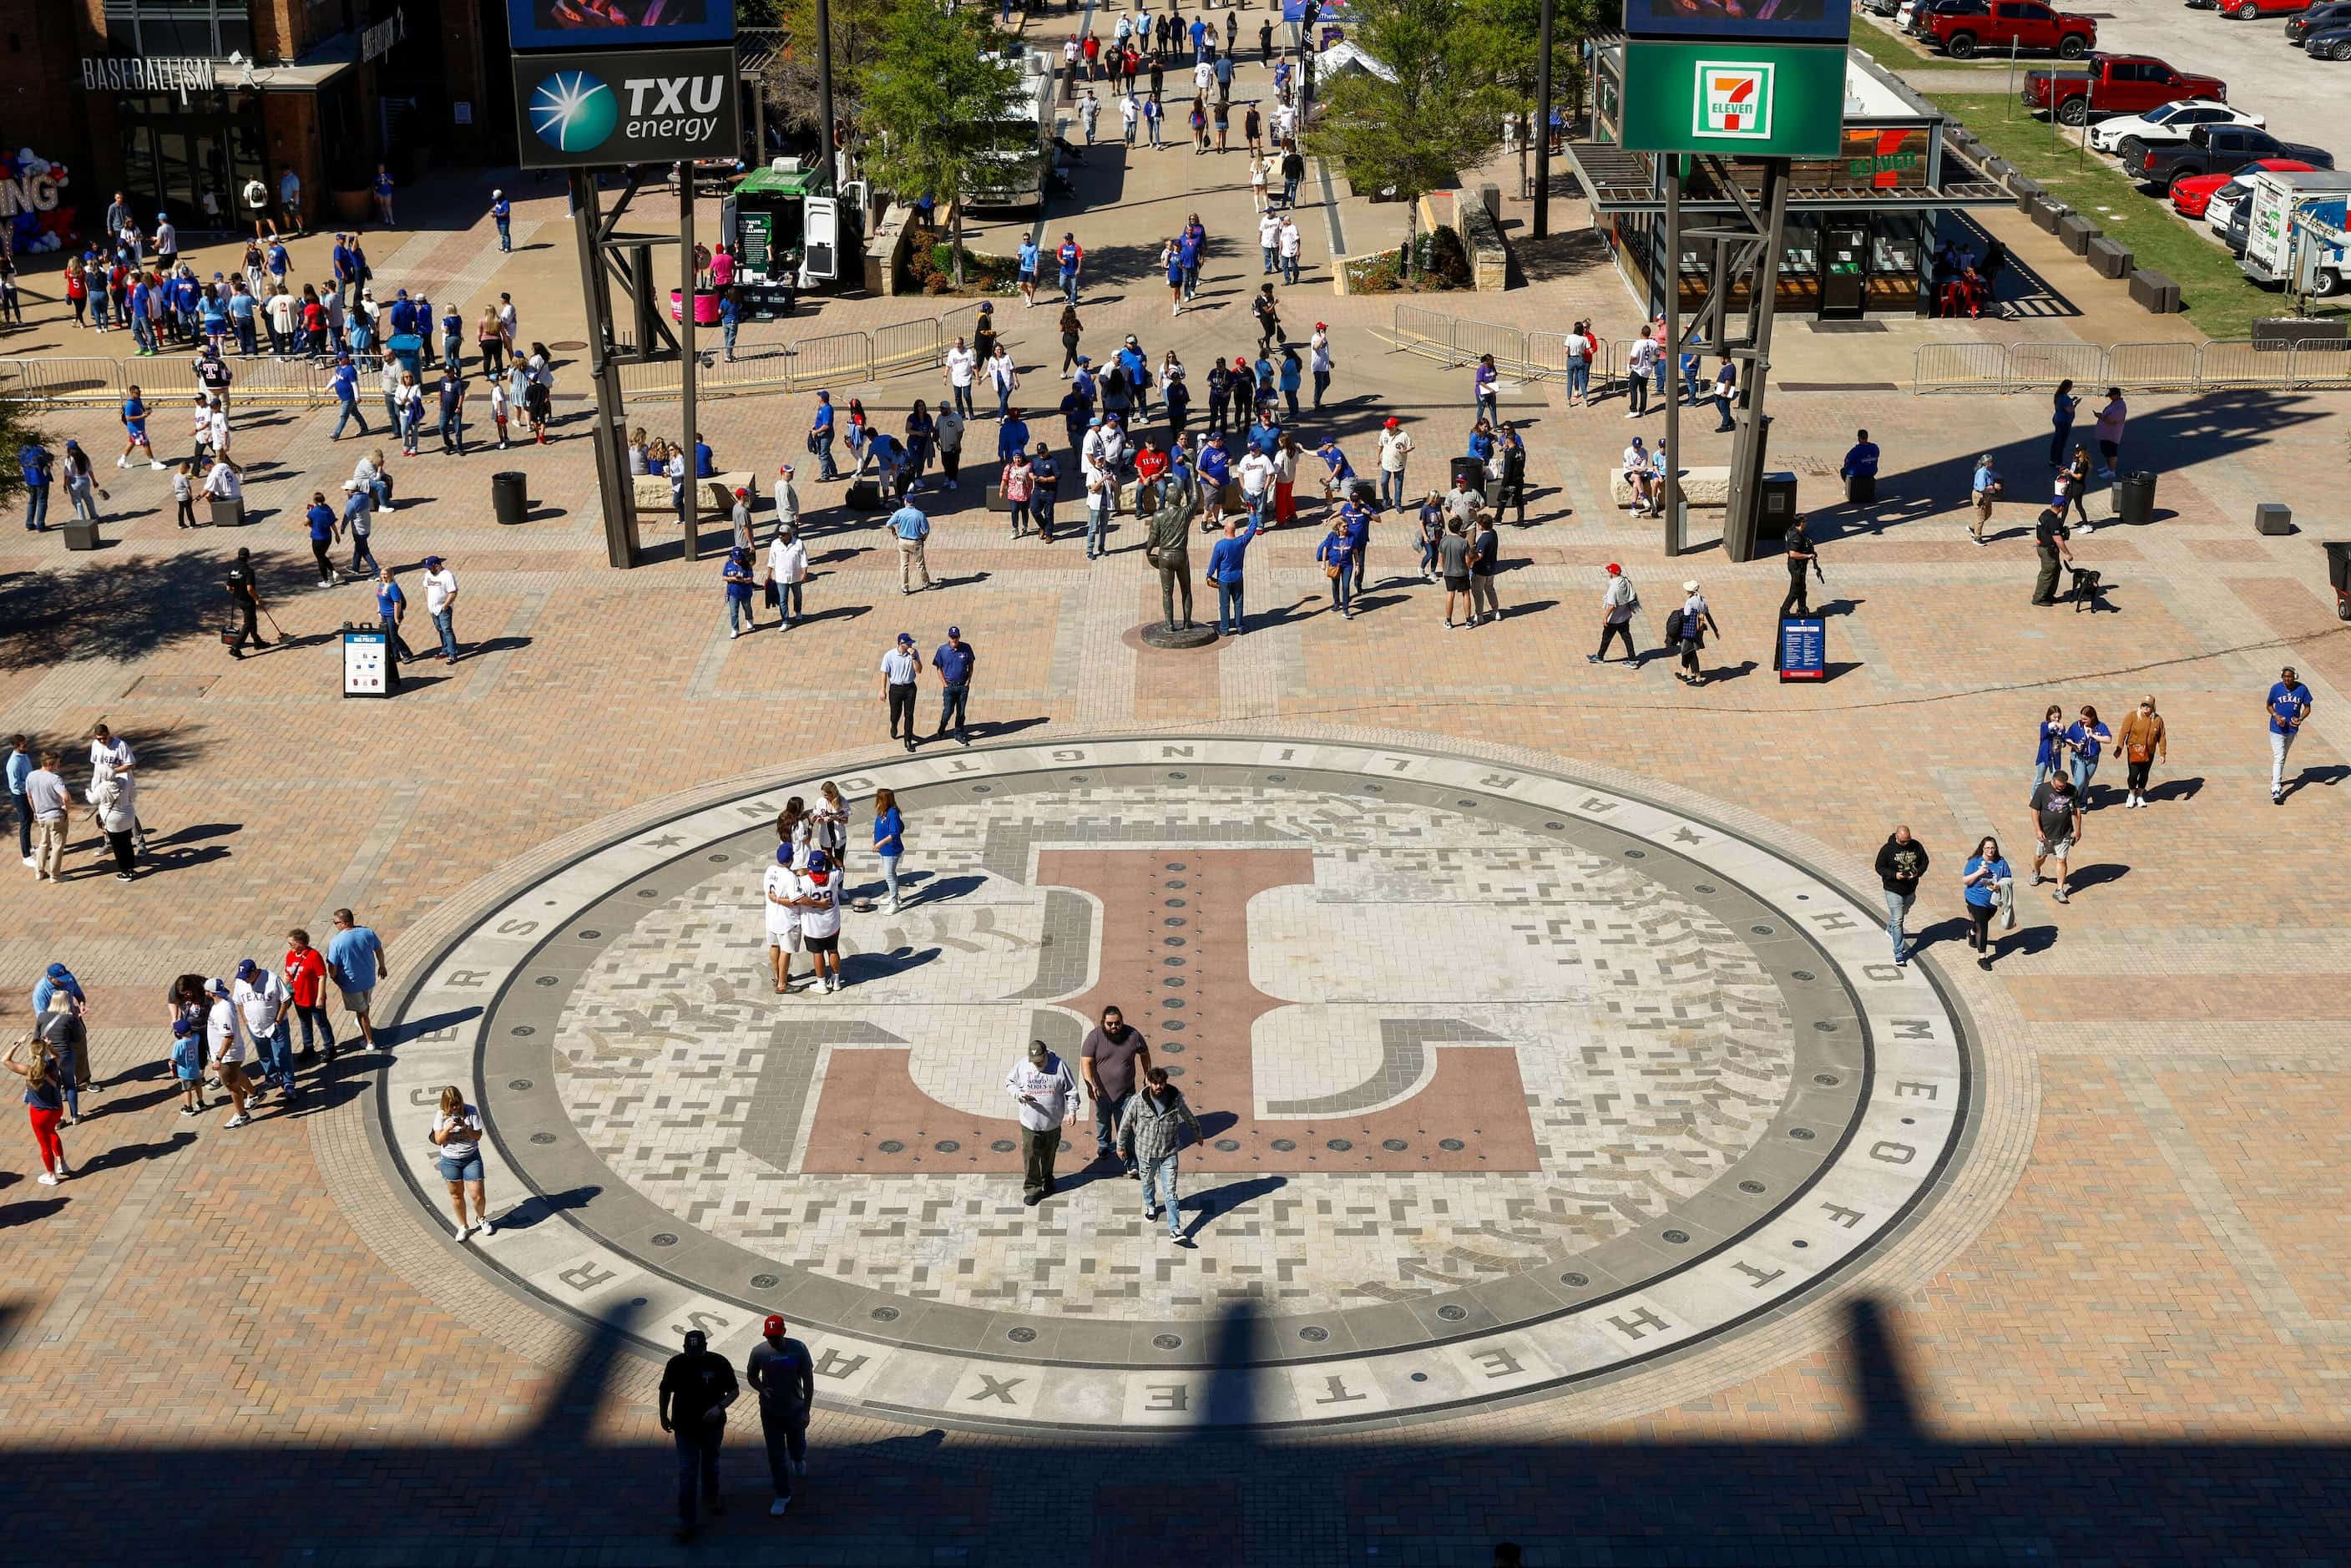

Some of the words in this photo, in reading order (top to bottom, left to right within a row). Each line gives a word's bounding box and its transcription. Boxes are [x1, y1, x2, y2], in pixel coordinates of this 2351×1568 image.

[82, 58, 215, 106] BASEBALLISM
[624, 75, 724, 116] TXU
[625, 117, 717, 142] energy
[203, 363, 218, 379] T
[2277, 695, 2301, 704] TEXAS
[240, 994, 272, 1004] TEXAS
[768, 1321, 775, 1329] T
